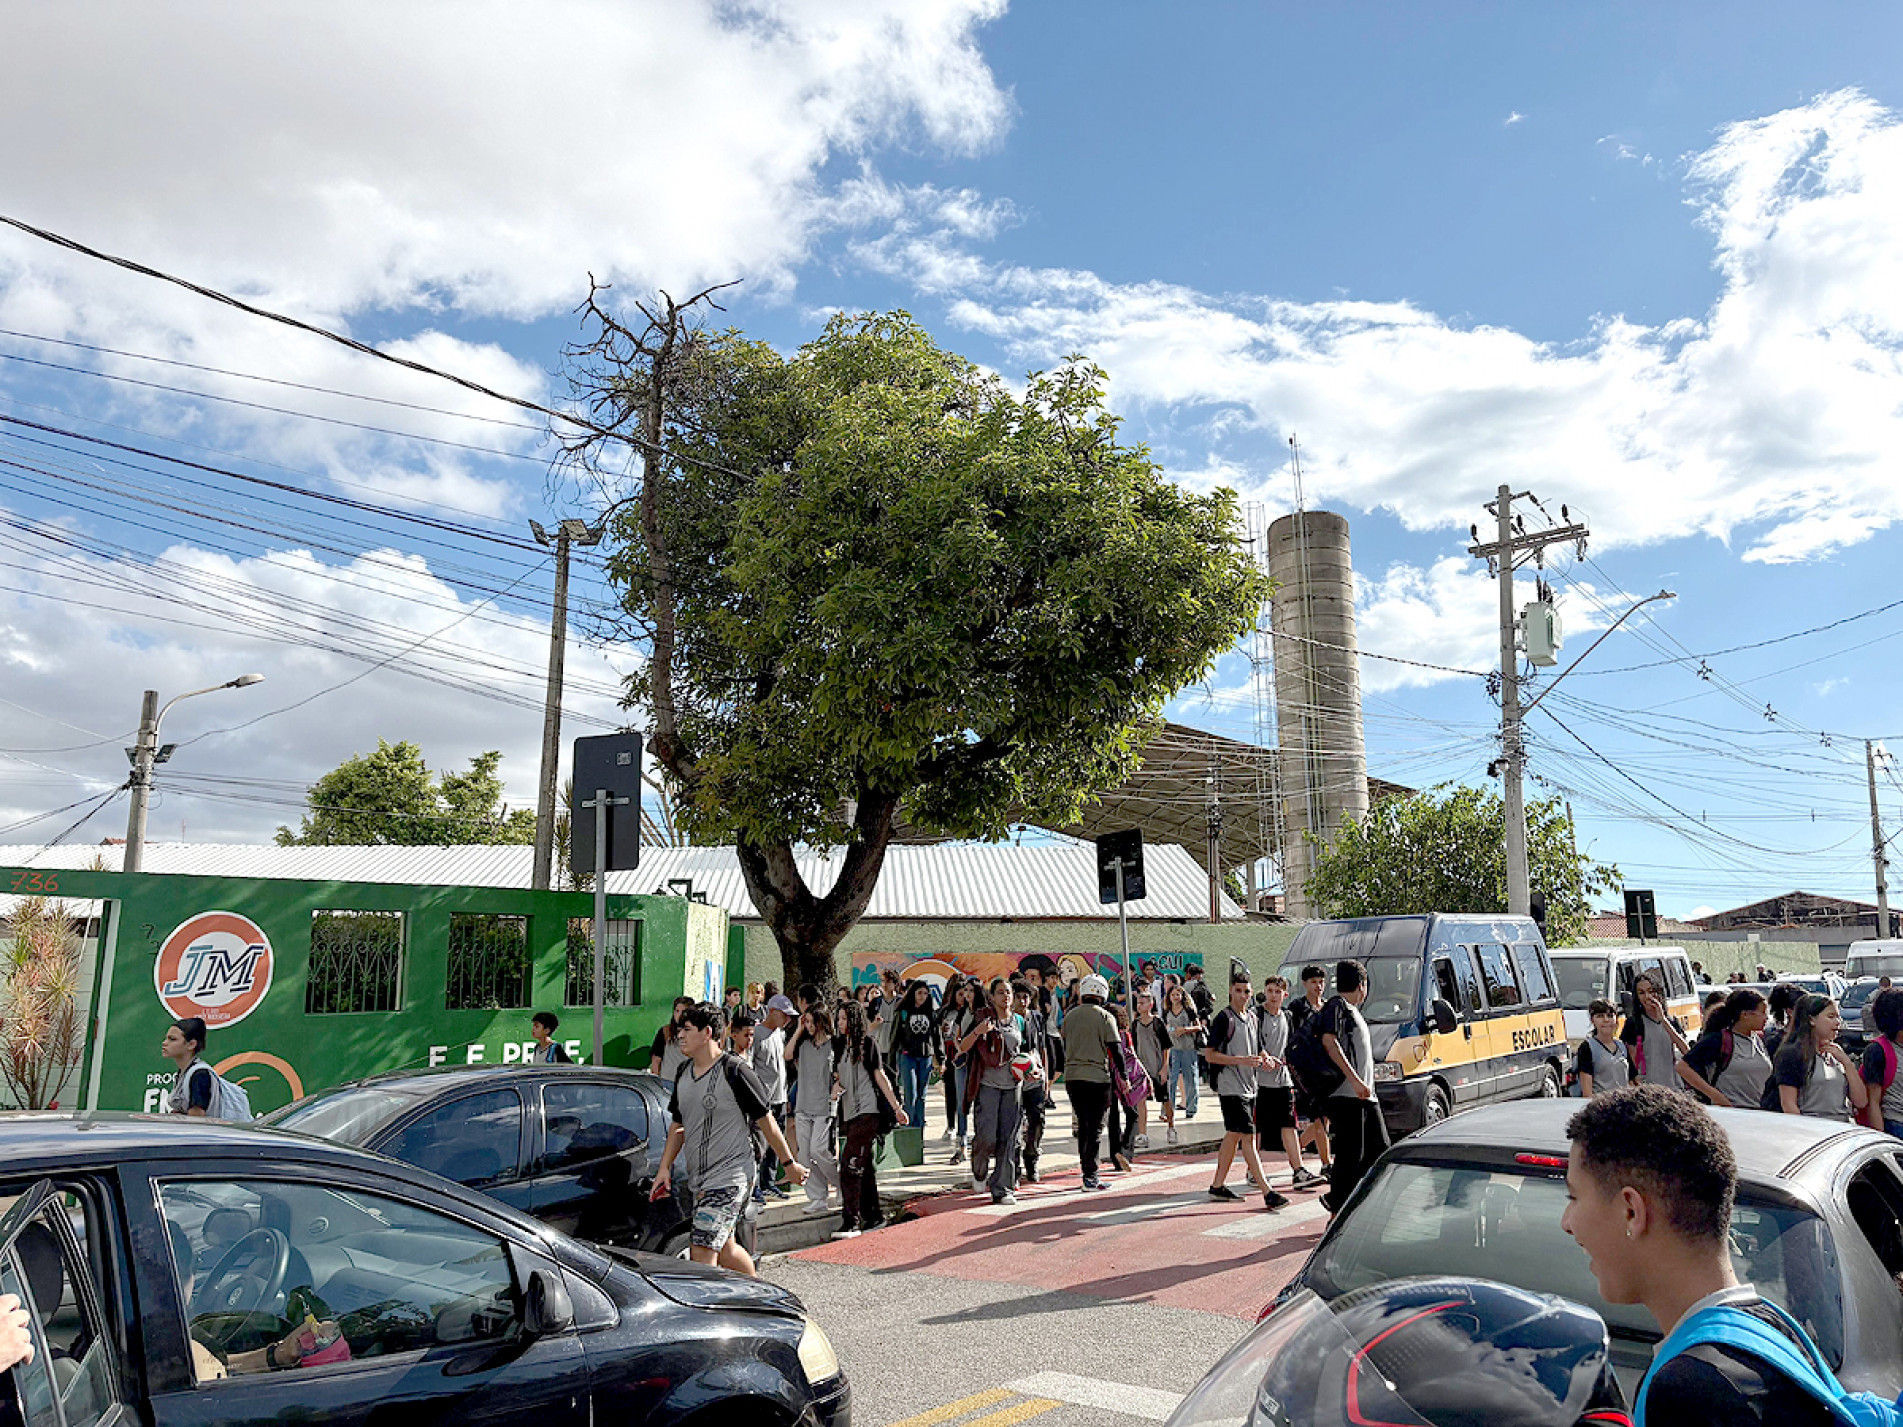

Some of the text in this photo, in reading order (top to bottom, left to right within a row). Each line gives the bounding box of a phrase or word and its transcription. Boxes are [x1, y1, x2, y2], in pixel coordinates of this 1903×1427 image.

[10, 871, 59, 892] 736
[164, 944, 264, 997] JM
[1512, 1025, 1555, 1051] ESCOLAR
